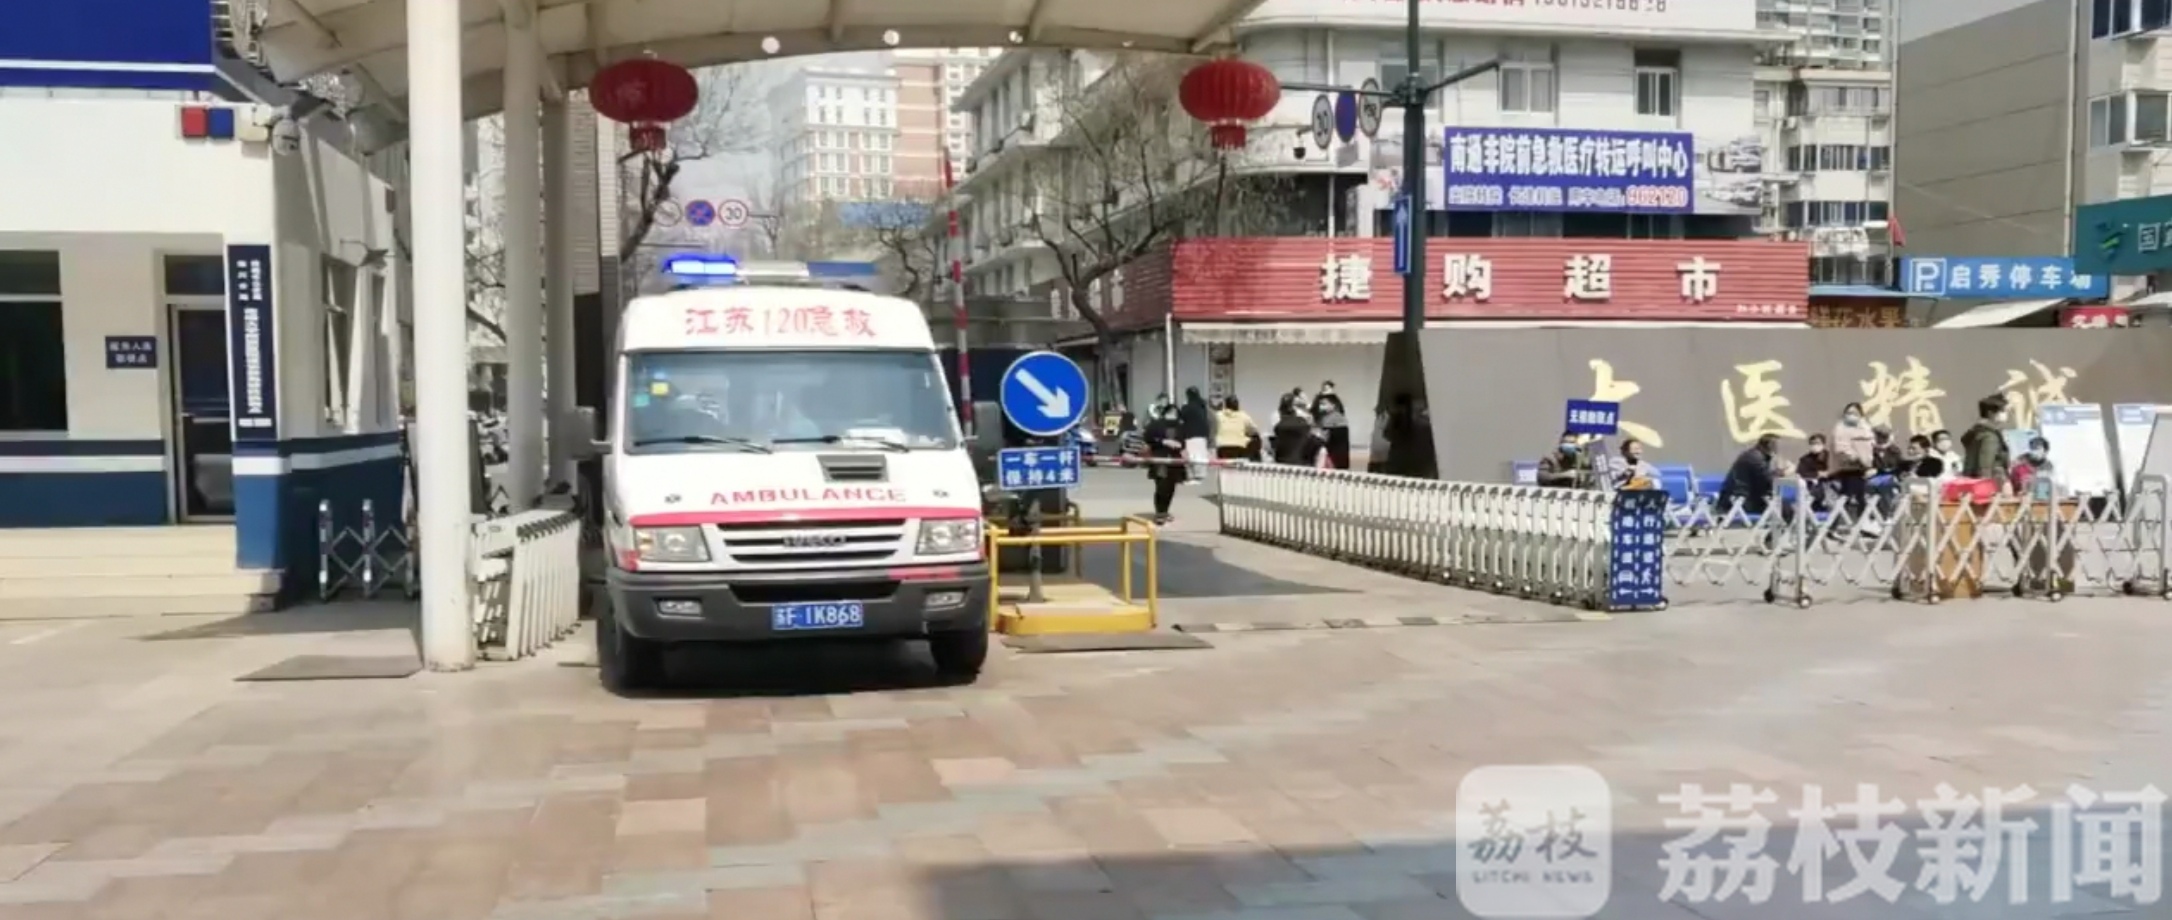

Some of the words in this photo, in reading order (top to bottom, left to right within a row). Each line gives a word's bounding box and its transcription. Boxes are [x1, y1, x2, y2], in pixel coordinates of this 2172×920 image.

[1450, 132, 1689, 178] 南通非院前急救医疗转运呼叫中心
[726, 207, 743, 220] 30
[1320, 254, 1721, 301] 捷购超市
[1949, 264, 2092, 290] 启秀停车场
[685, 306, 877, 337] 江苏120急救
[1005, 452, 1074, 467] 一车一杆
[1006, 468, 1075, 486] 保持4米
[711, 488, 906, 505] AMBULANCE
